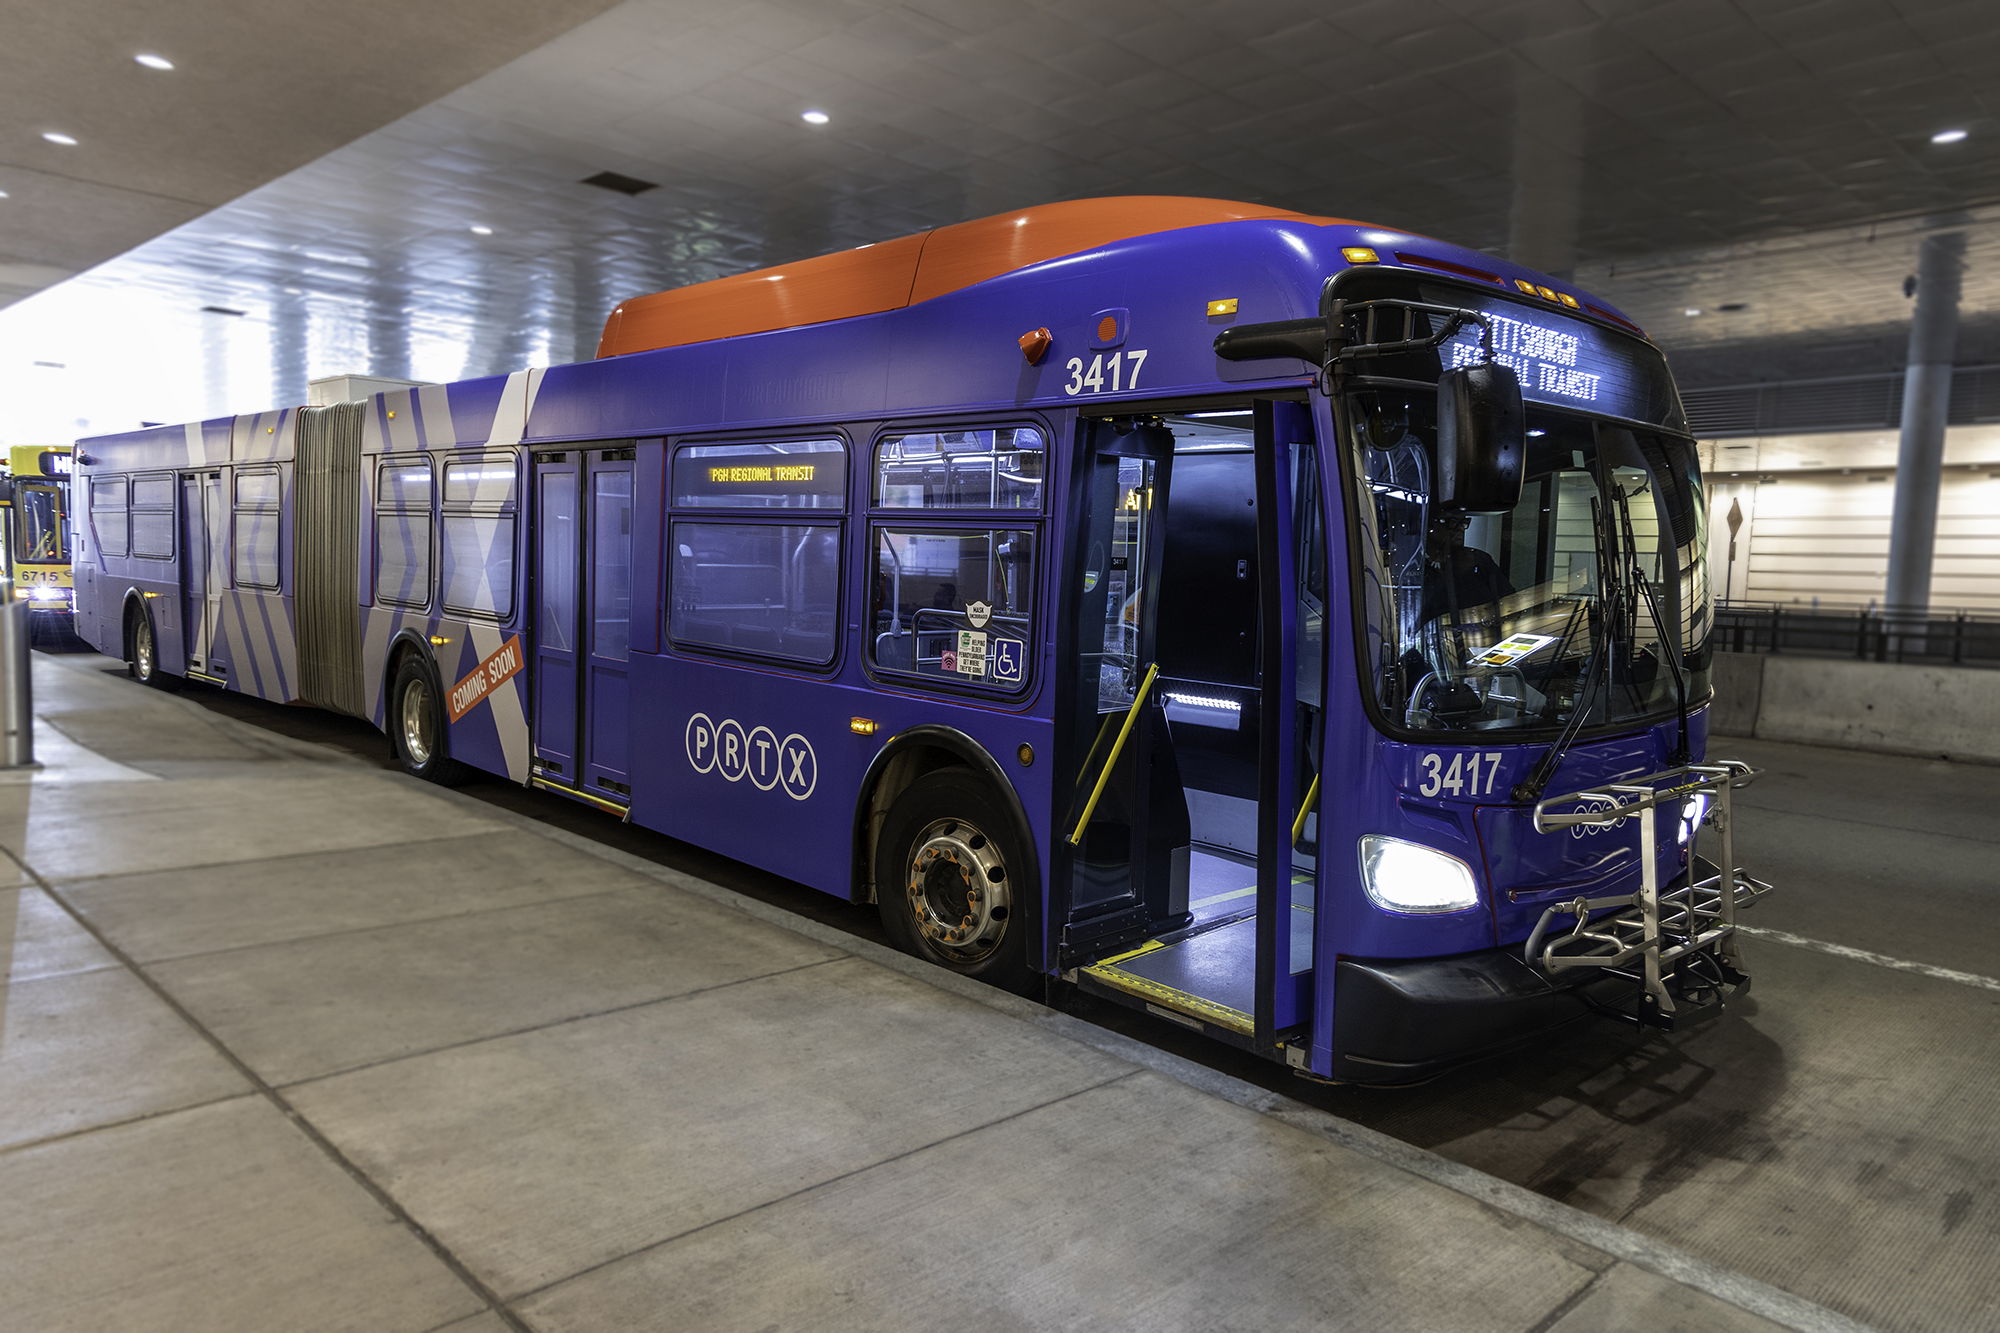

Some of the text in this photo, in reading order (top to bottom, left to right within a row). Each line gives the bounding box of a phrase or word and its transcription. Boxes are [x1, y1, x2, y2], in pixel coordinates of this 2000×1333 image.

[1064, 349, 1148, 396] 3417
[1538, 362, 1600, 400] TRANSIT
[711, 465, 815, 482] PGH REGIONAL TRANSIT
[22, 571, 58, 582] 6715
[972, 606, 984, 614] MASK
[452, 645, 516, 713] COMING SOON
[694, 723, 808, 789] PRTX
[1419, 752, 1502, 798] 3417
